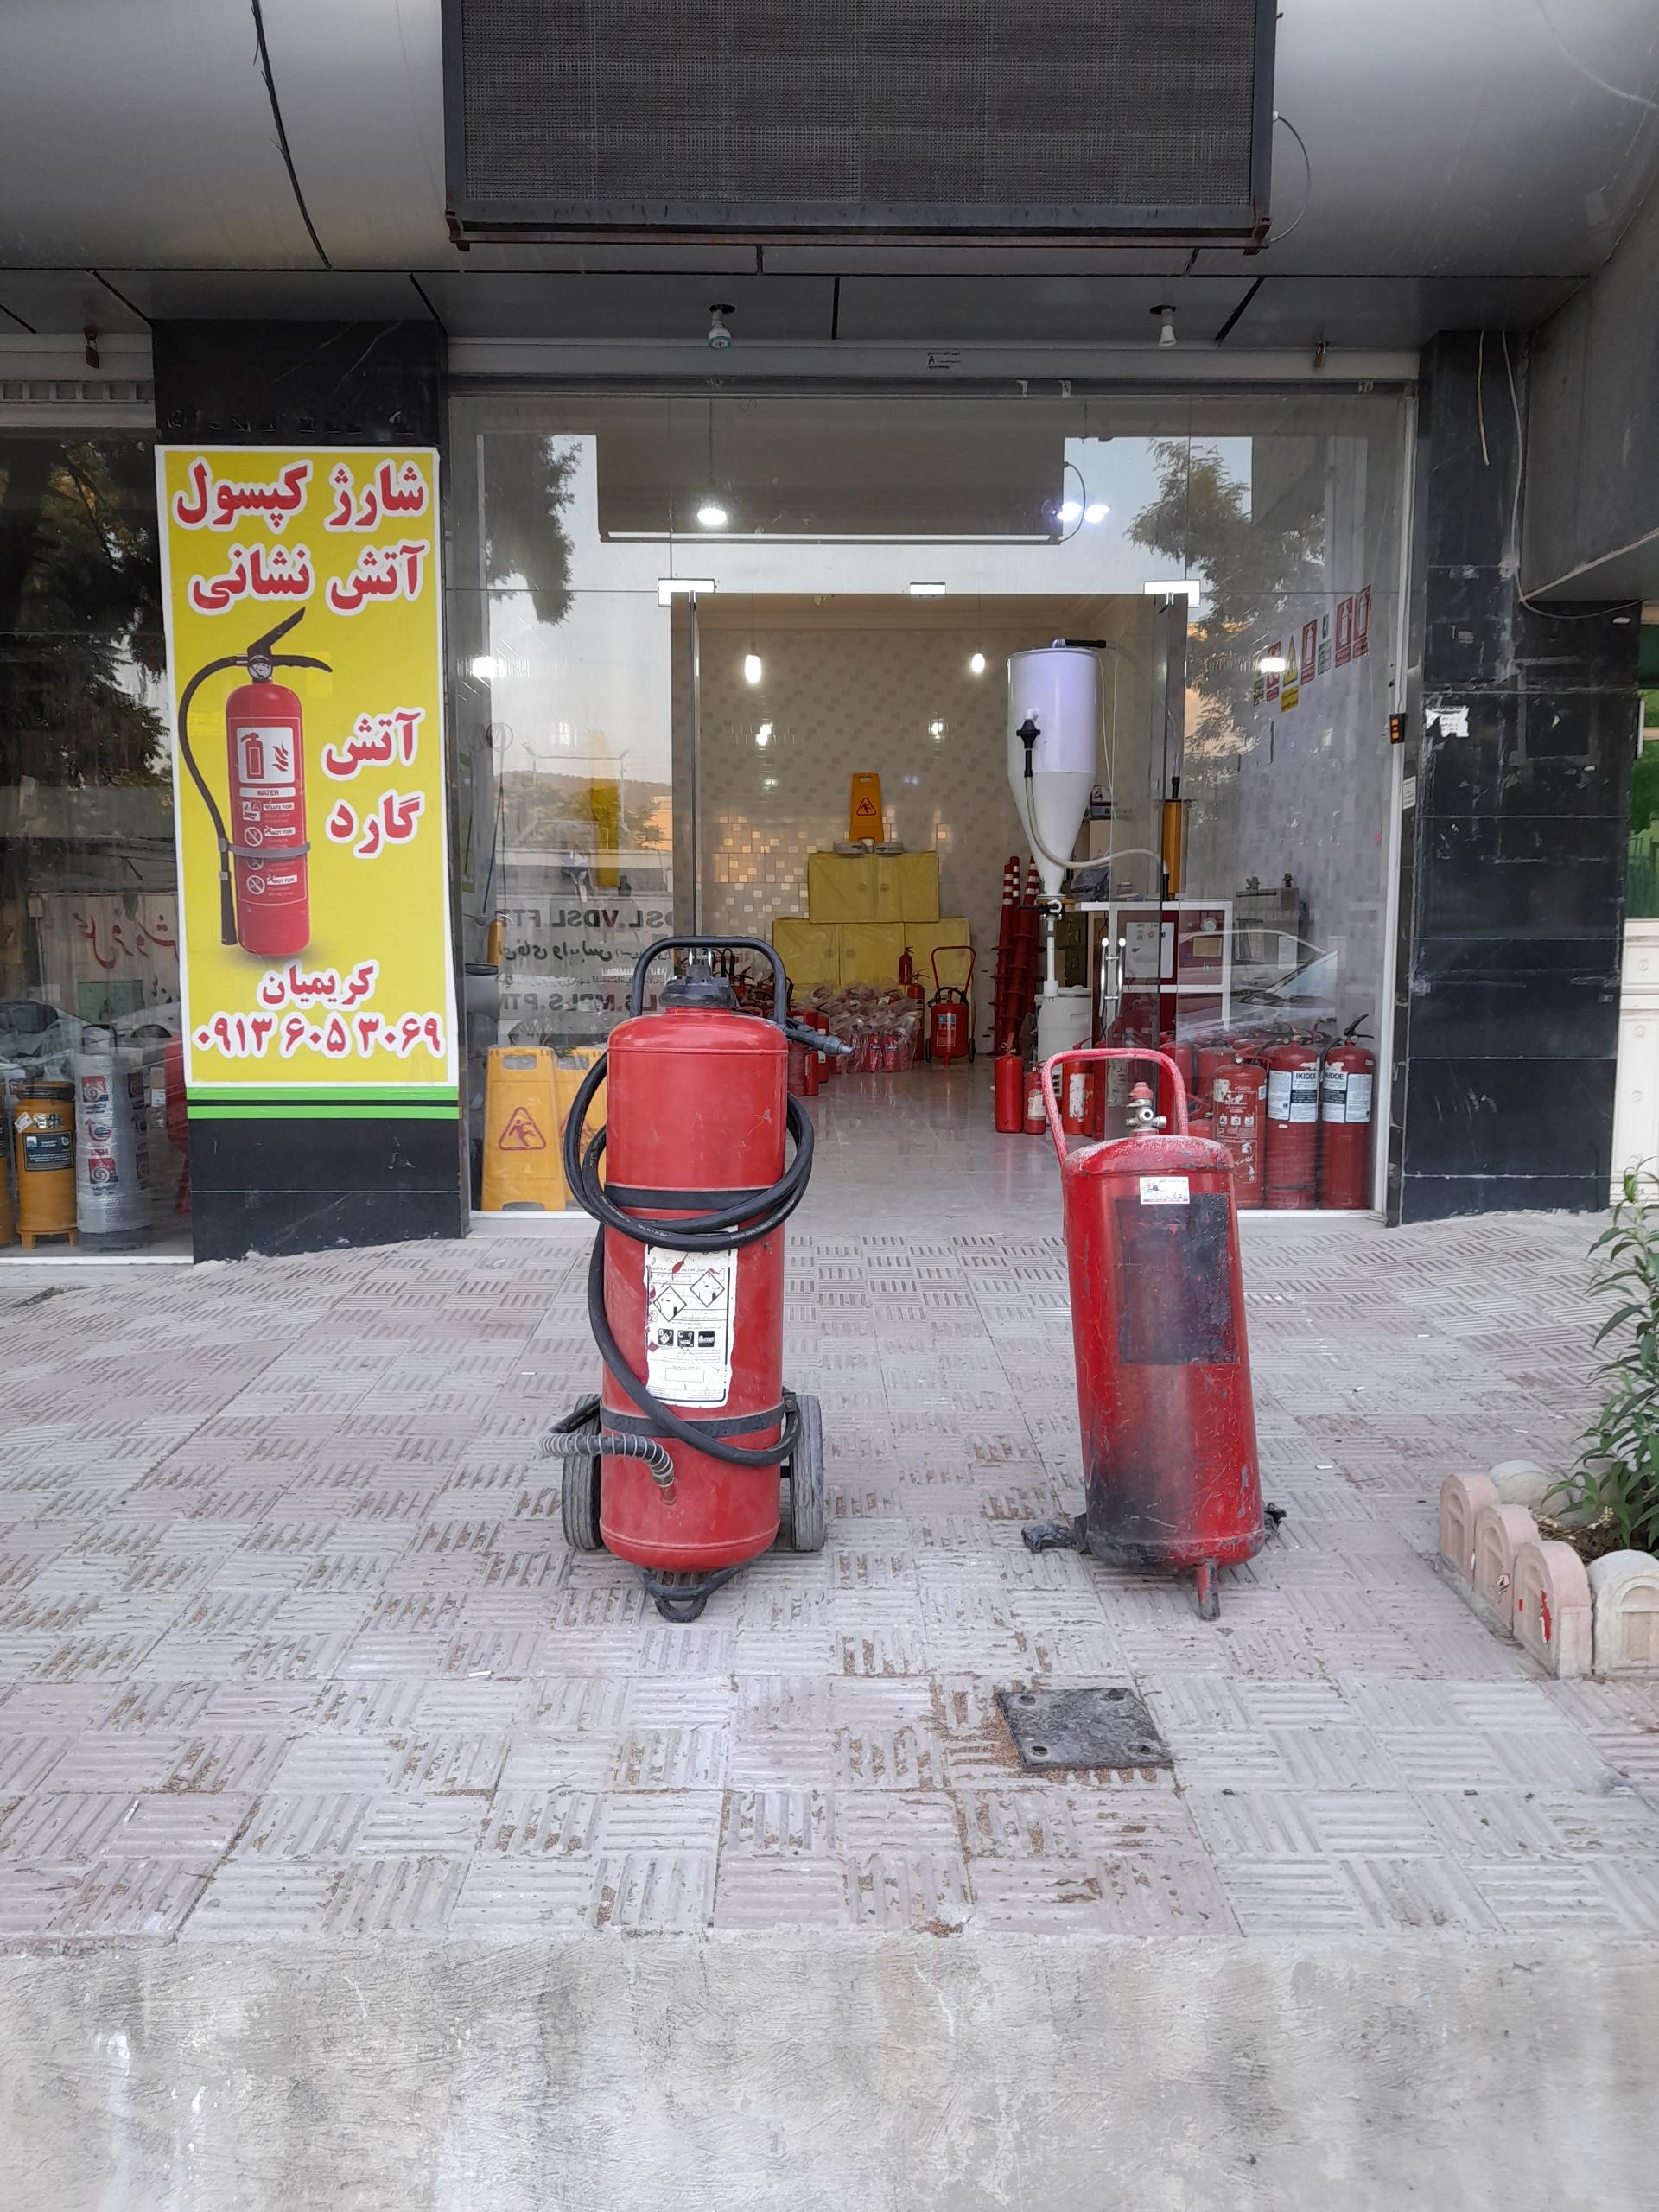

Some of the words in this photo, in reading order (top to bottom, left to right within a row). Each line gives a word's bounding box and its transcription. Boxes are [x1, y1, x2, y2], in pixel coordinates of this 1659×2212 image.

[176, 462, 308, 528] کپسول
[328, 466, 424, 526] شارژ
[192, 549, 310, 609] نشانی
[330, 544, 425, 609] آتش
[326, 711, 421, 775] آتش
[330, 795, 421, 854] گارد
[263, 965, 374, 1005] کریمیان
[198, 1017, 273, 1052] ۰۹۱۳
[359, 1017, 441, 1052] ۳۰۶۹
